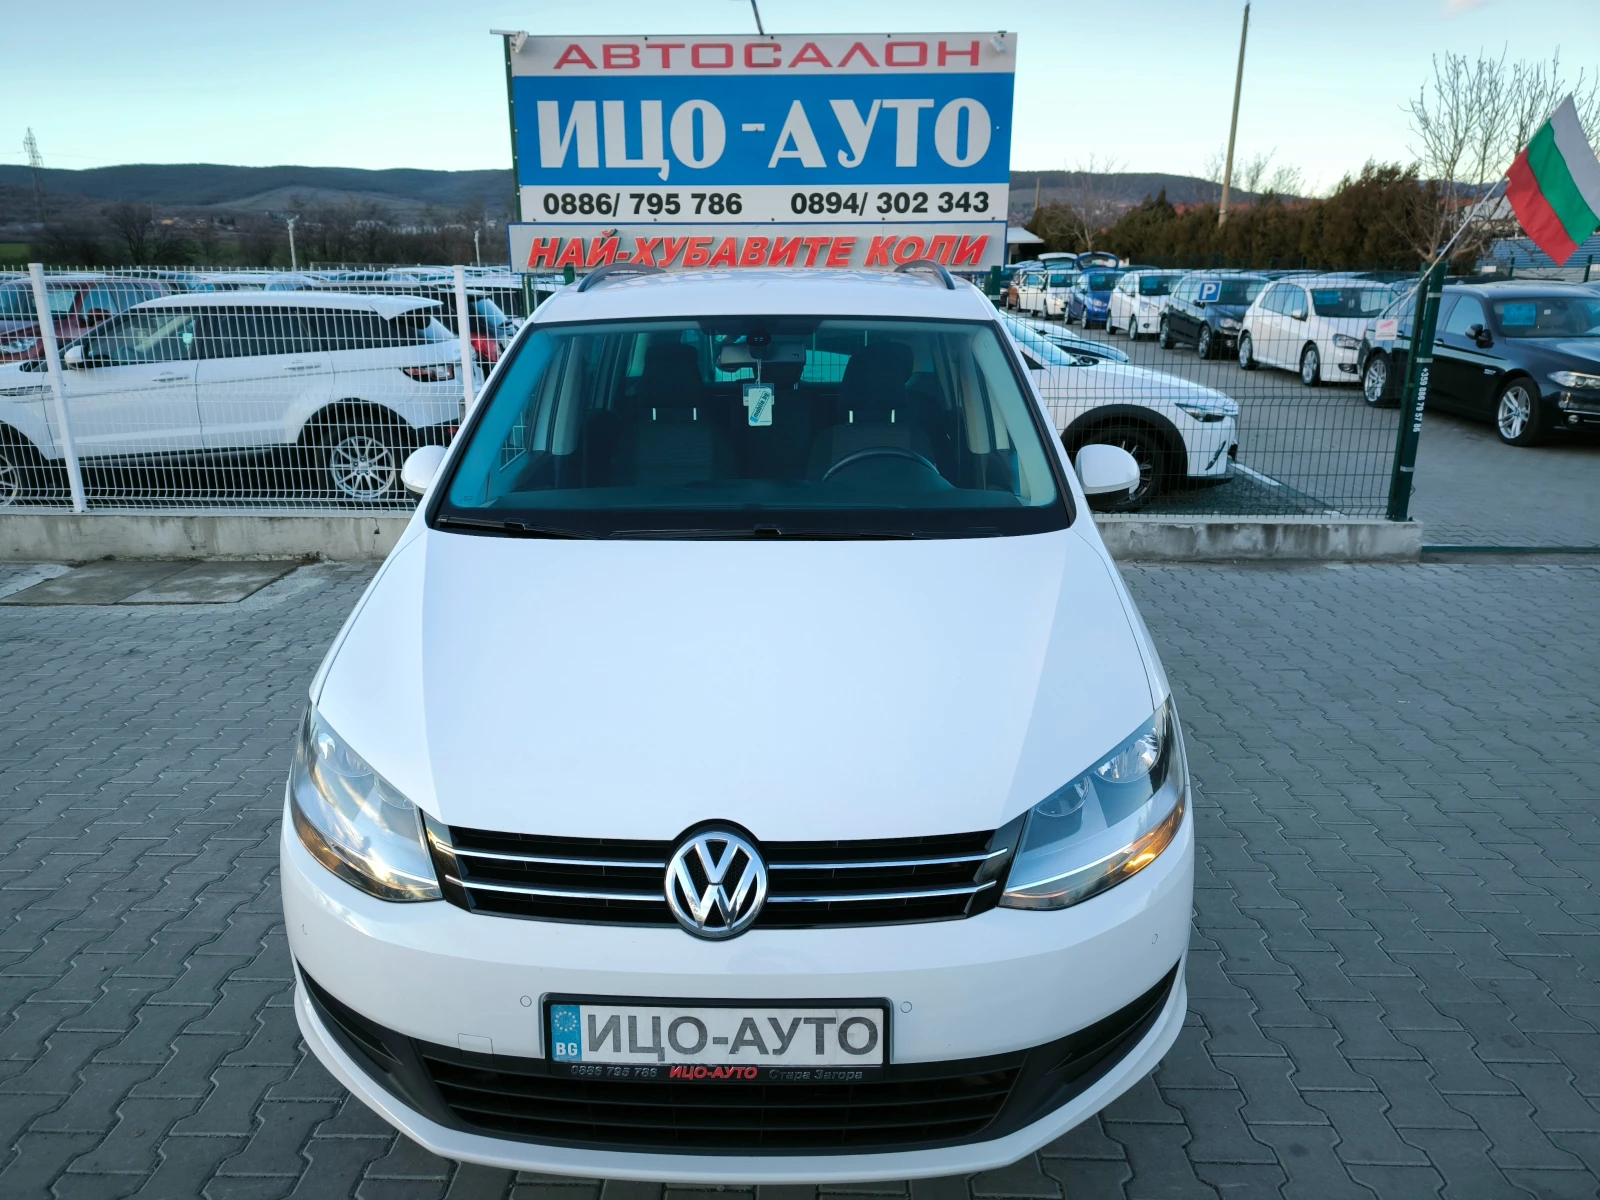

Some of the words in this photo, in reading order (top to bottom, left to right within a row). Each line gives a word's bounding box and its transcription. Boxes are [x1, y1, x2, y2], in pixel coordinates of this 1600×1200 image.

[553, 40, 980, 70] АВТОСАЛОН
[543, 192, 621, 217] 0886/
[630, 192, 681, 215] 795
[690, 192, 743, 215] 786
[790, 192, 868, 216] 0894/
[876, 191, 929, 214] 302
[937, 190, 989, 214] 343
[526, 228, 860, 269] НАЙ-ХУБАВИТЕ
[864, 234, 991, 267] КОЛИ
[1201, 283, 1217, 300] P
[555, 1042, 578, 1057] BG
[587, 1015, 879, 1062] ИЦО-АУТО
[669, 1065, 758, 1080] ИЦО-АУТО
[768, 1069, 811, 1080] Стара
[814, 1069, 863, 1080] Загора
